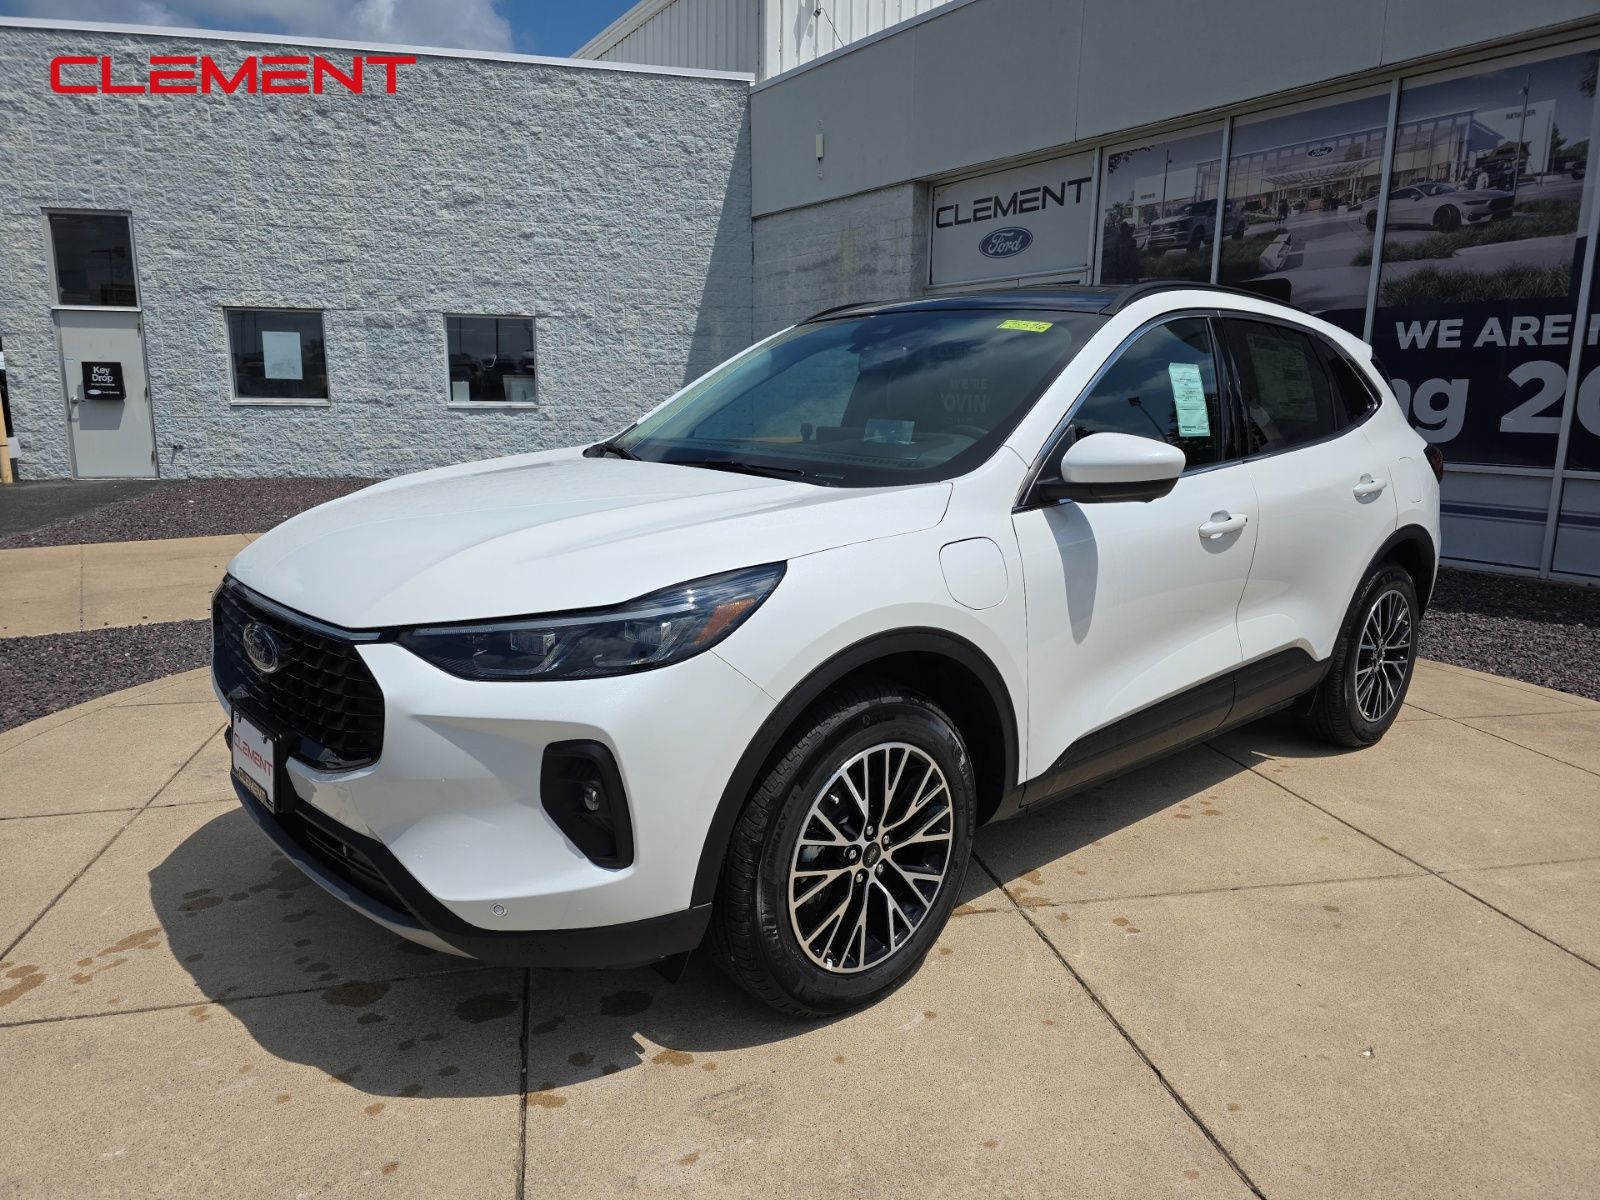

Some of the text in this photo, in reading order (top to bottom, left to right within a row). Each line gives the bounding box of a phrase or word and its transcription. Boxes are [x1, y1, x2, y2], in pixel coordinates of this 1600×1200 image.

[936, 177, 1092, 229] CLEMENT
[988, 231, 1023, 254] Ford
[1395, 319, 1464, 350] WE
[1473, 314, 1572, 348] ARE
[91, 374, 114, 383] Drop
[93, 366, 110, 375] Key
[234, 732, 273, 776] CLEMENT
